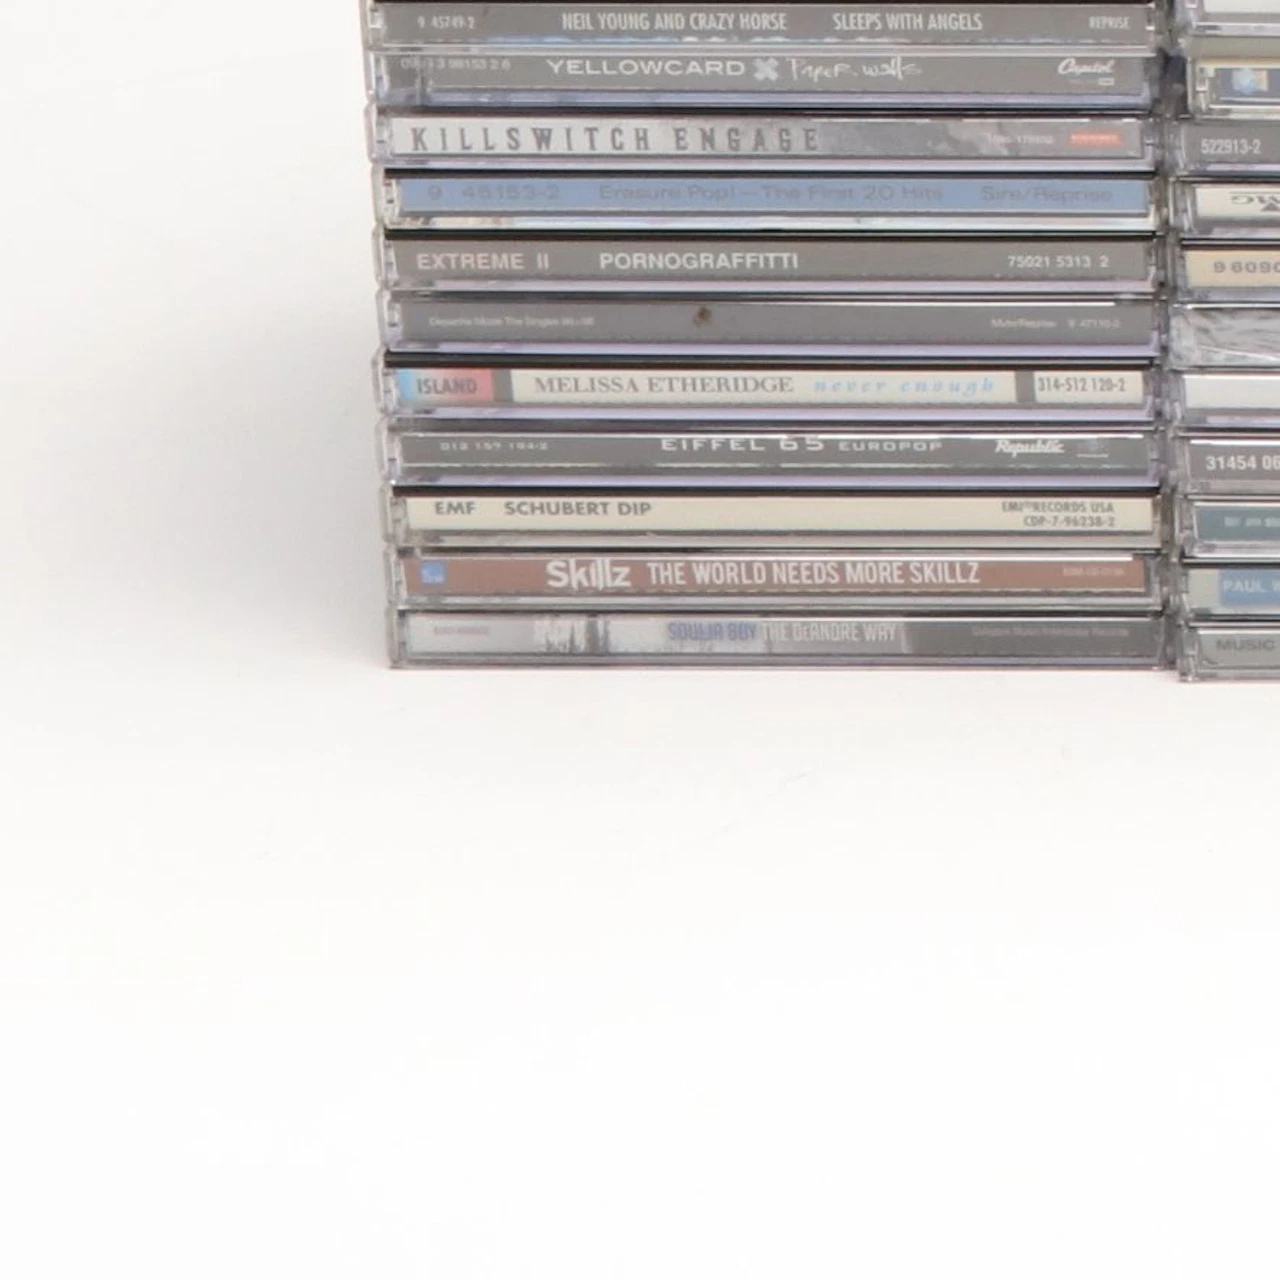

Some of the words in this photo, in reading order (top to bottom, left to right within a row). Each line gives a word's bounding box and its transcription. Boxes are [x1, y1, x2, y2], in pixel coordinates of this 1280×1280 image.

[412, 127, 650, 151] KILLSWITCH
[675, 127, 817, 153] ENGAGE
[417, 253, 523, 269] EXTREME
[537, 253, 549, 269] II
[536, 378, 638, 392] MELISSA
[648, 377, 792, 392] ETHERIDGE
[435, 502, 474, 514] EMF
[505, 502, 608, 515] SCHUBERT
[618, 502, 651, 515] DIP
